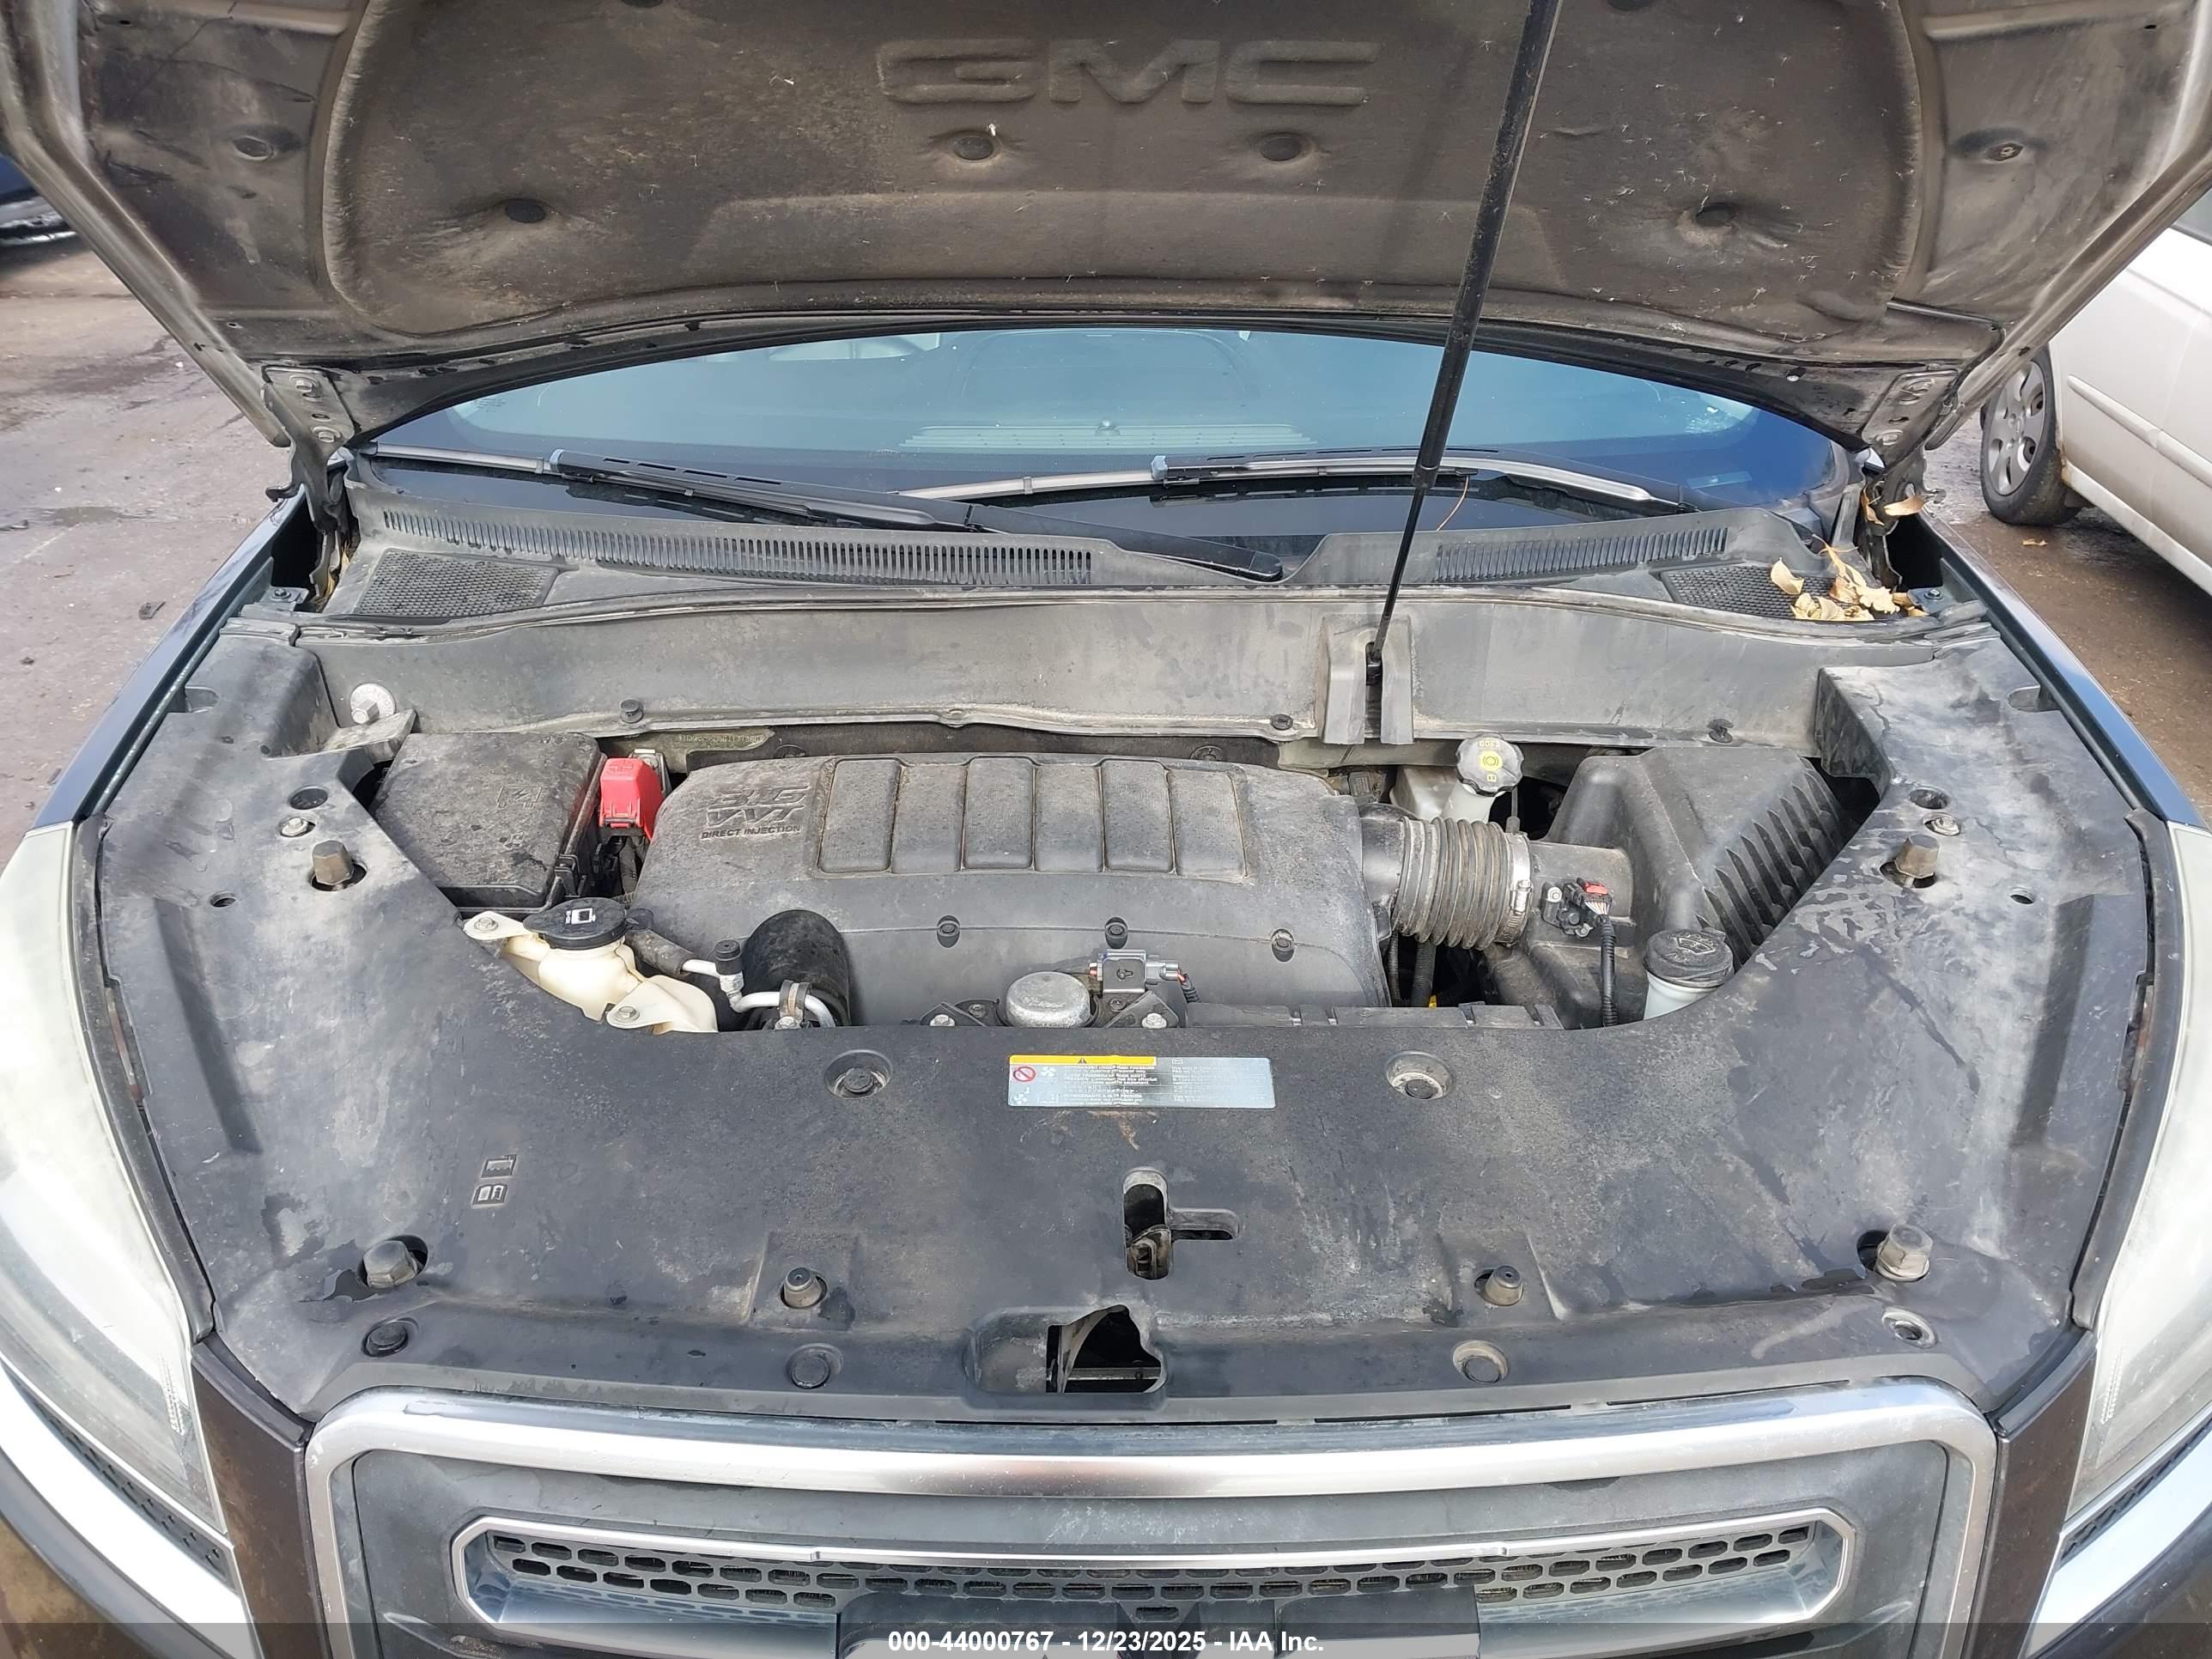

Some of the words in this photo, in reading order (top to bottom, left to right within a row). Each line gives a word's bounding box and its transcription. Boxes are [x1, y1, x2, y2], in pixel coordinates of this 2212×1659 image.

[874, 39, 1376, 105] GMC
[707, 806, 805, 828] VVT
[700, 829, 742, 840] DIRECT
[744, 824, 801, 836] INJECTION
